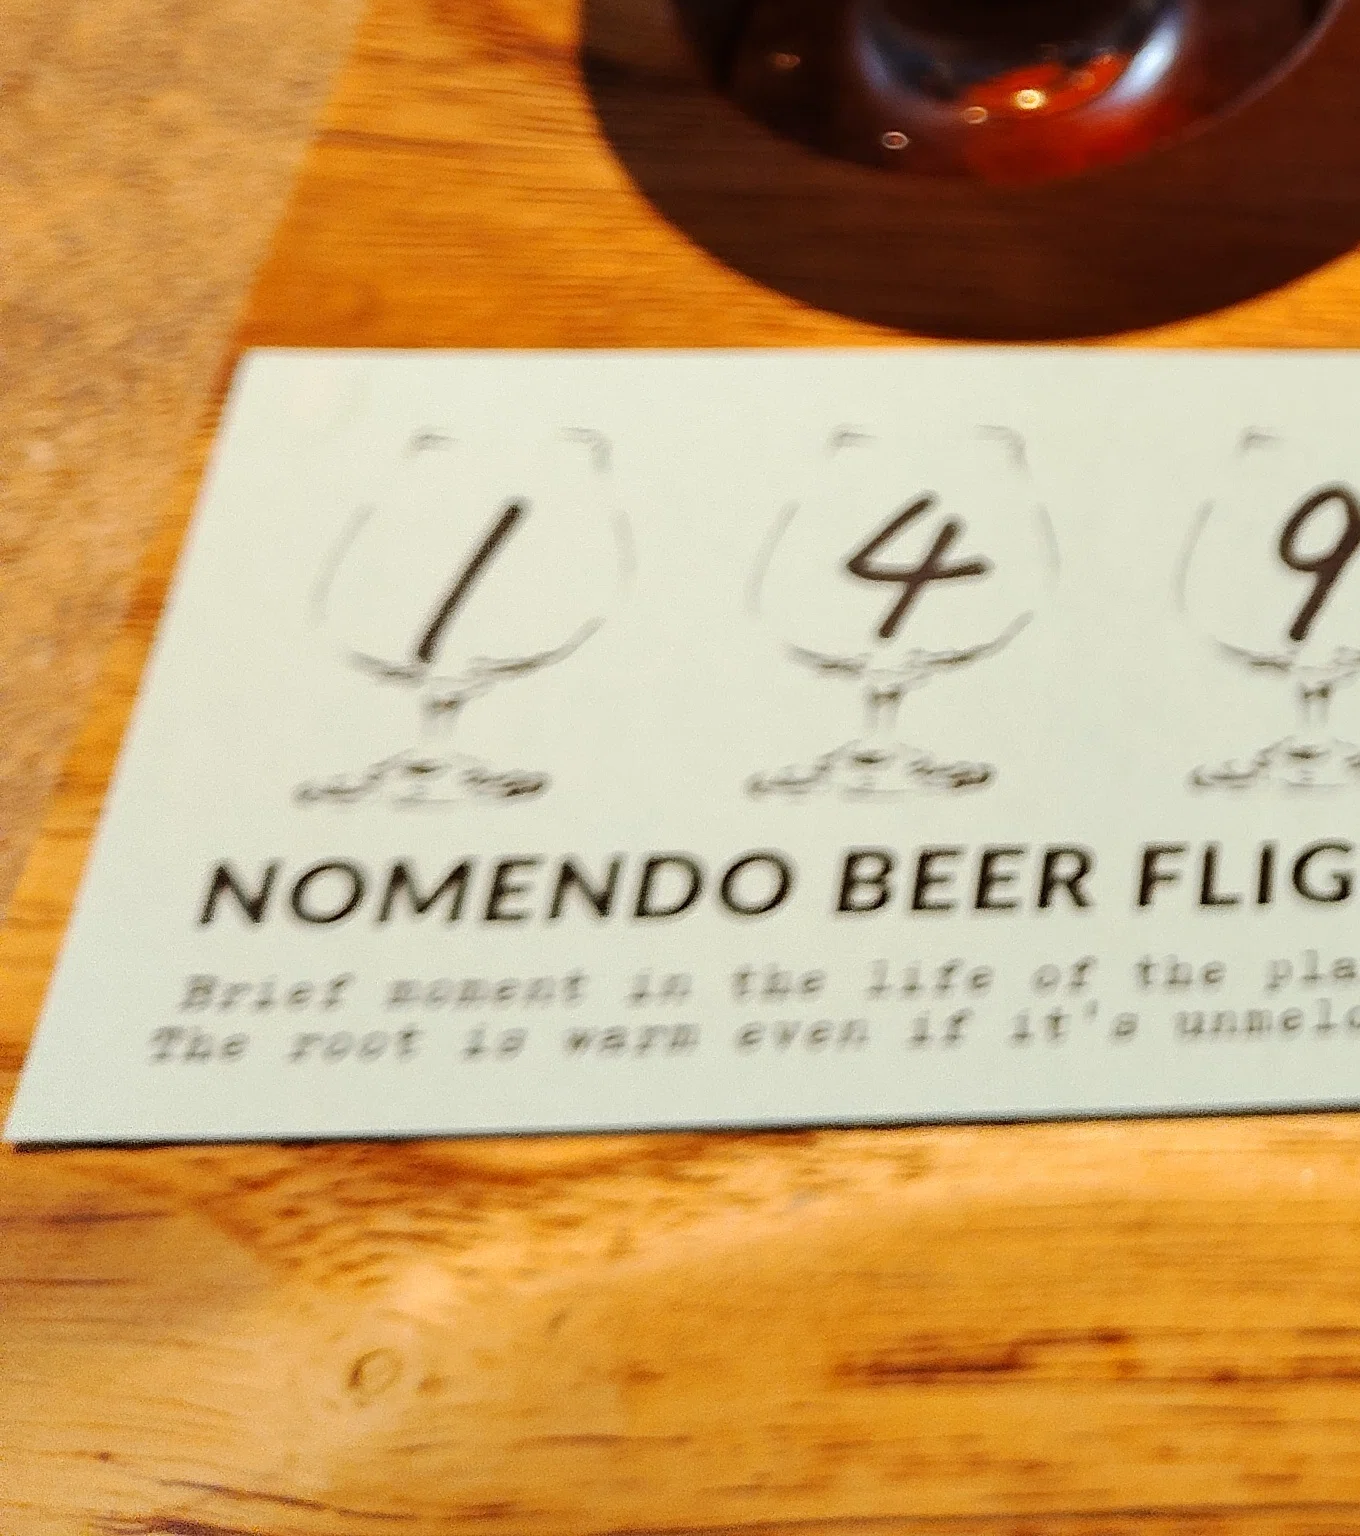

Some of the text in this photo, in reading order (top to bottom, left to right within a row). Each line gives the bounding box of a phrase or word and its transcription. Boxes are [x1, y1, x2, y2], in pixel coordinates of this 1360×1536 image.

[412, 498, 528, 664] 1
[842, 491, 992, 642] 4
[198, 850, 797, 926] NOMENDO
[834, 844, 1094, 916] BEER
[178, 971, 358, 1013] Brief
[384, 969, 589, 1010] moment
[627, 967, 694, 1006] in
[731, 963, 828, 1003] the
[866, 957, 995, 1000] life
[1031, 954, 1100, 996] of
[1133, 954, 1226, 994] the
[150, 1025, 250, 1062] The
[288, 1024, 422, 1063] root
[464, 1023, 529, 1060] is
[565, 1021, 699, 1056] warm
[736, 1017, 871, 1052] even
[910, 1007, 975, 1048] if
[1010, 998, 1138, 1045] it's
